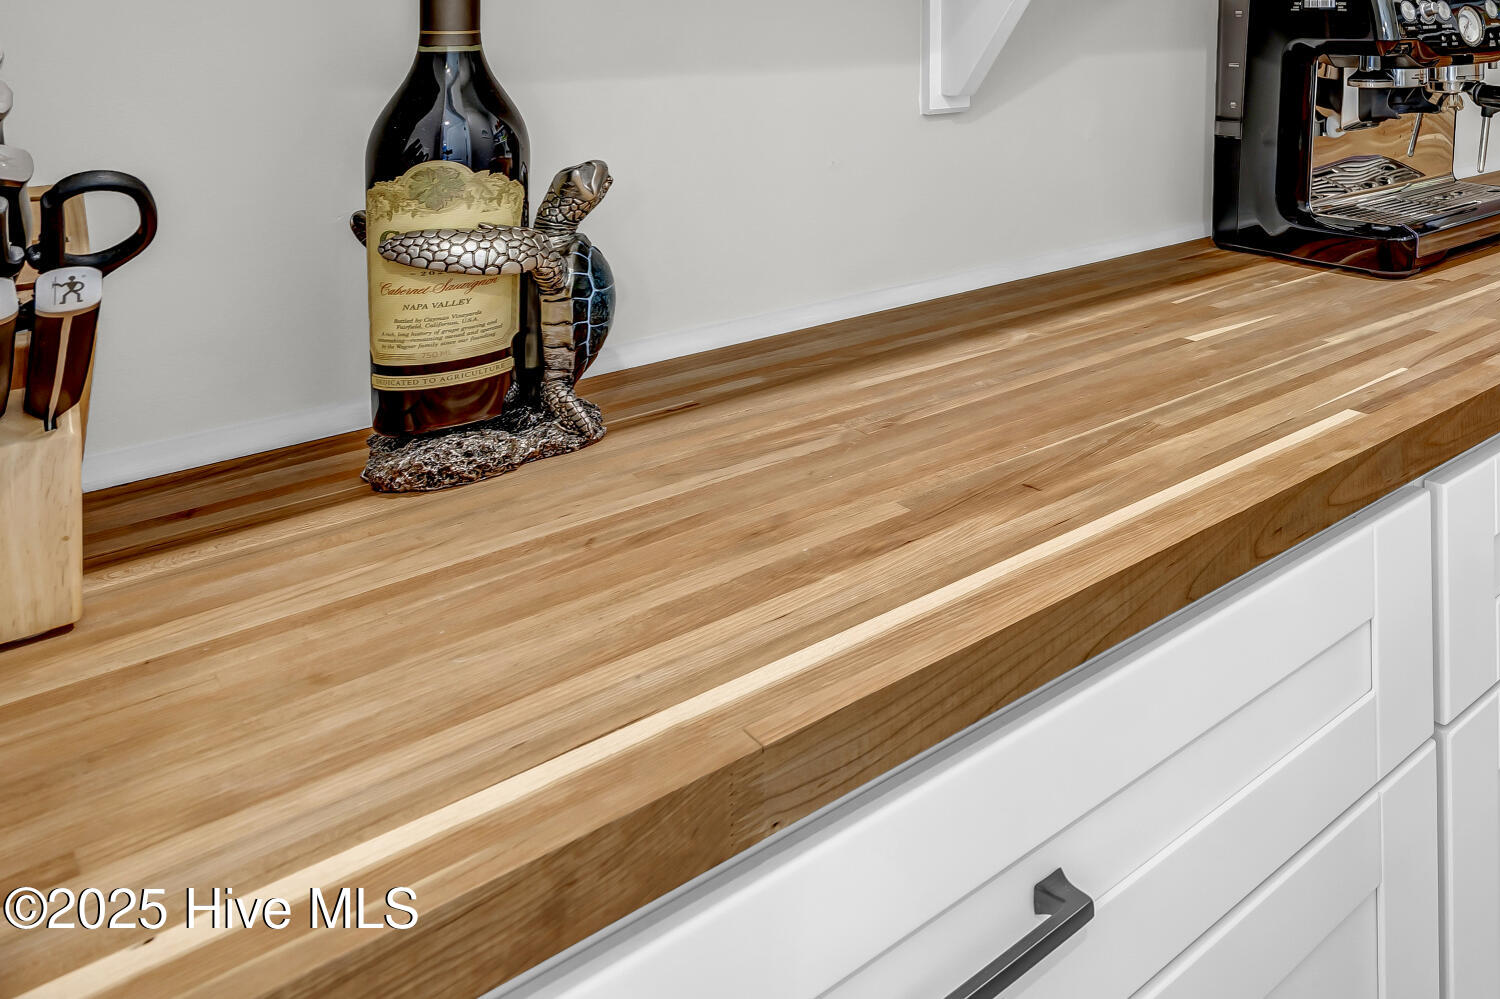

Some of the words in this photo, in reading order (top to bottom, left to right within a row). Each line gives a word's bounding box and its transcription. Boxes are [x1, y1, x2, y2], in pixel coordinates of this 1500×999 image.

[380, 282, 430, 296] Cabernet
[431, 276, 499, 294] Sauvignon
[402, 303, 429, 311] NAPA
[432, 298, 472, 309] VALLEY
[422, 377, 437, 385] TO
[439, 362, 506, 384] AGRICULTURE
